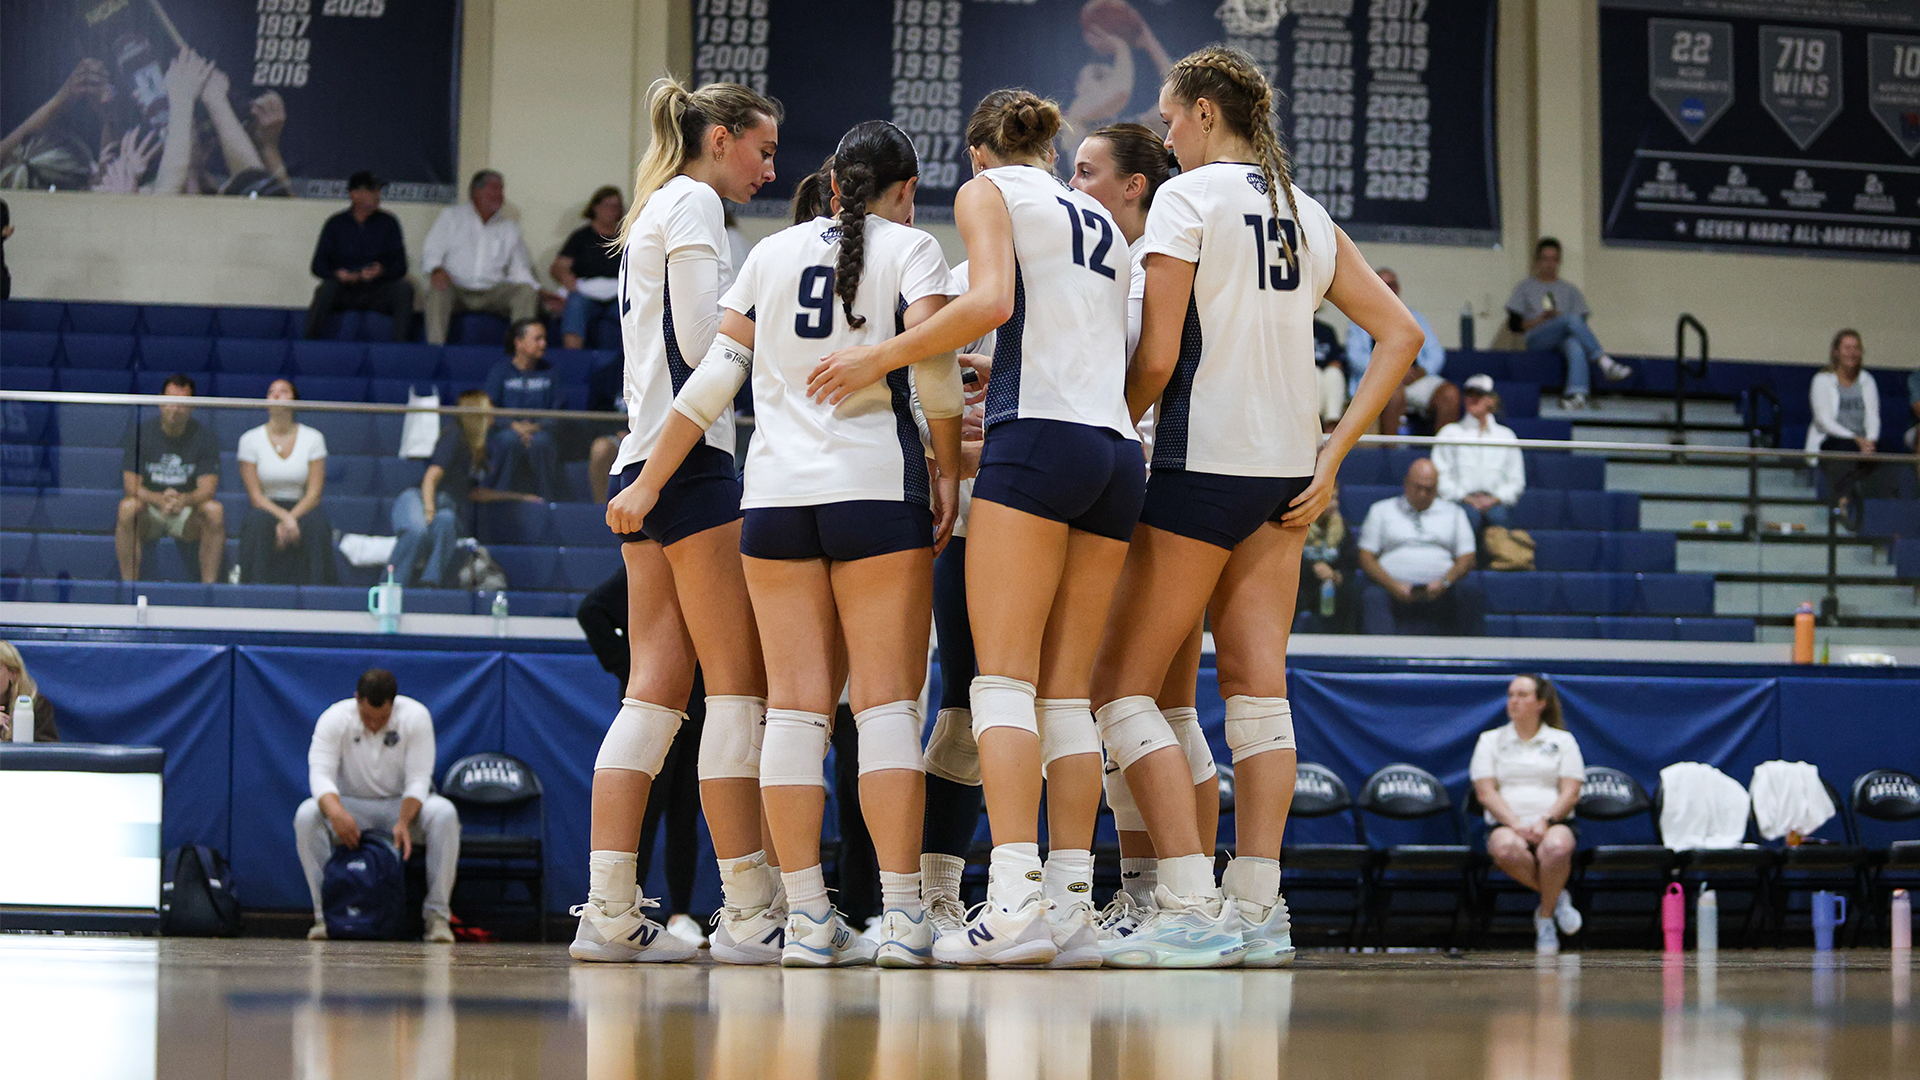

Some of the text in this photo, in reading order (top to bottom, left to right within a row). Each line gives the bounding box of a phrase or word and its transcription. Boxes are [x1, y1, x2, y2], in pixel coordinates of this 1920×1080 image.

[257, 14, 312, 36] 1997
[893, 0, 962, 25] 1993
[697, 17, 770, 44] 1999
[892, 26, 962, 53] 1995
[255, 38, 311, 60] 1999
[697, 45, 769, 71] 2000
[1294, 41, 1352, 65] 2001
[1671, 31, 1712, 63] 22
[1776, 37, 1825, 72] 719
[253, 62, 311, 87] 2016
[892, 53, 962, 79] 1996
[891, 80, 962, 106] 2005
[1773, 72, 1829, 97] WINS
[892, 106, 962, 132] 2006
[1366, 96, 1429, 121] 2020
[1294, 117, 1353, 141] 2010
[1365, 121, 1431, 147] 2022
[914, 135, 960, 159] 017
[1295, 142, 1354, 166] 2013
[1365, 147, 1431, 173] 2023
[917, 161, 960, 188] 20
[1295, 167, 1353, 192] 2014
[1055, 195, 1116, 281] 12
[1695, 219, 1746, 239] SEVEN
[1793, 224, 1911, 249] ALL-AMERICANS
[1243, 214, 1300, 291] 13
[794, 265, 834, 338] 9
[464, 767, 520, 787] ANSELM
[627, 925, 658, 947] N
[831, 927, 849, 948] N
[968, 923, 995, 946] N
